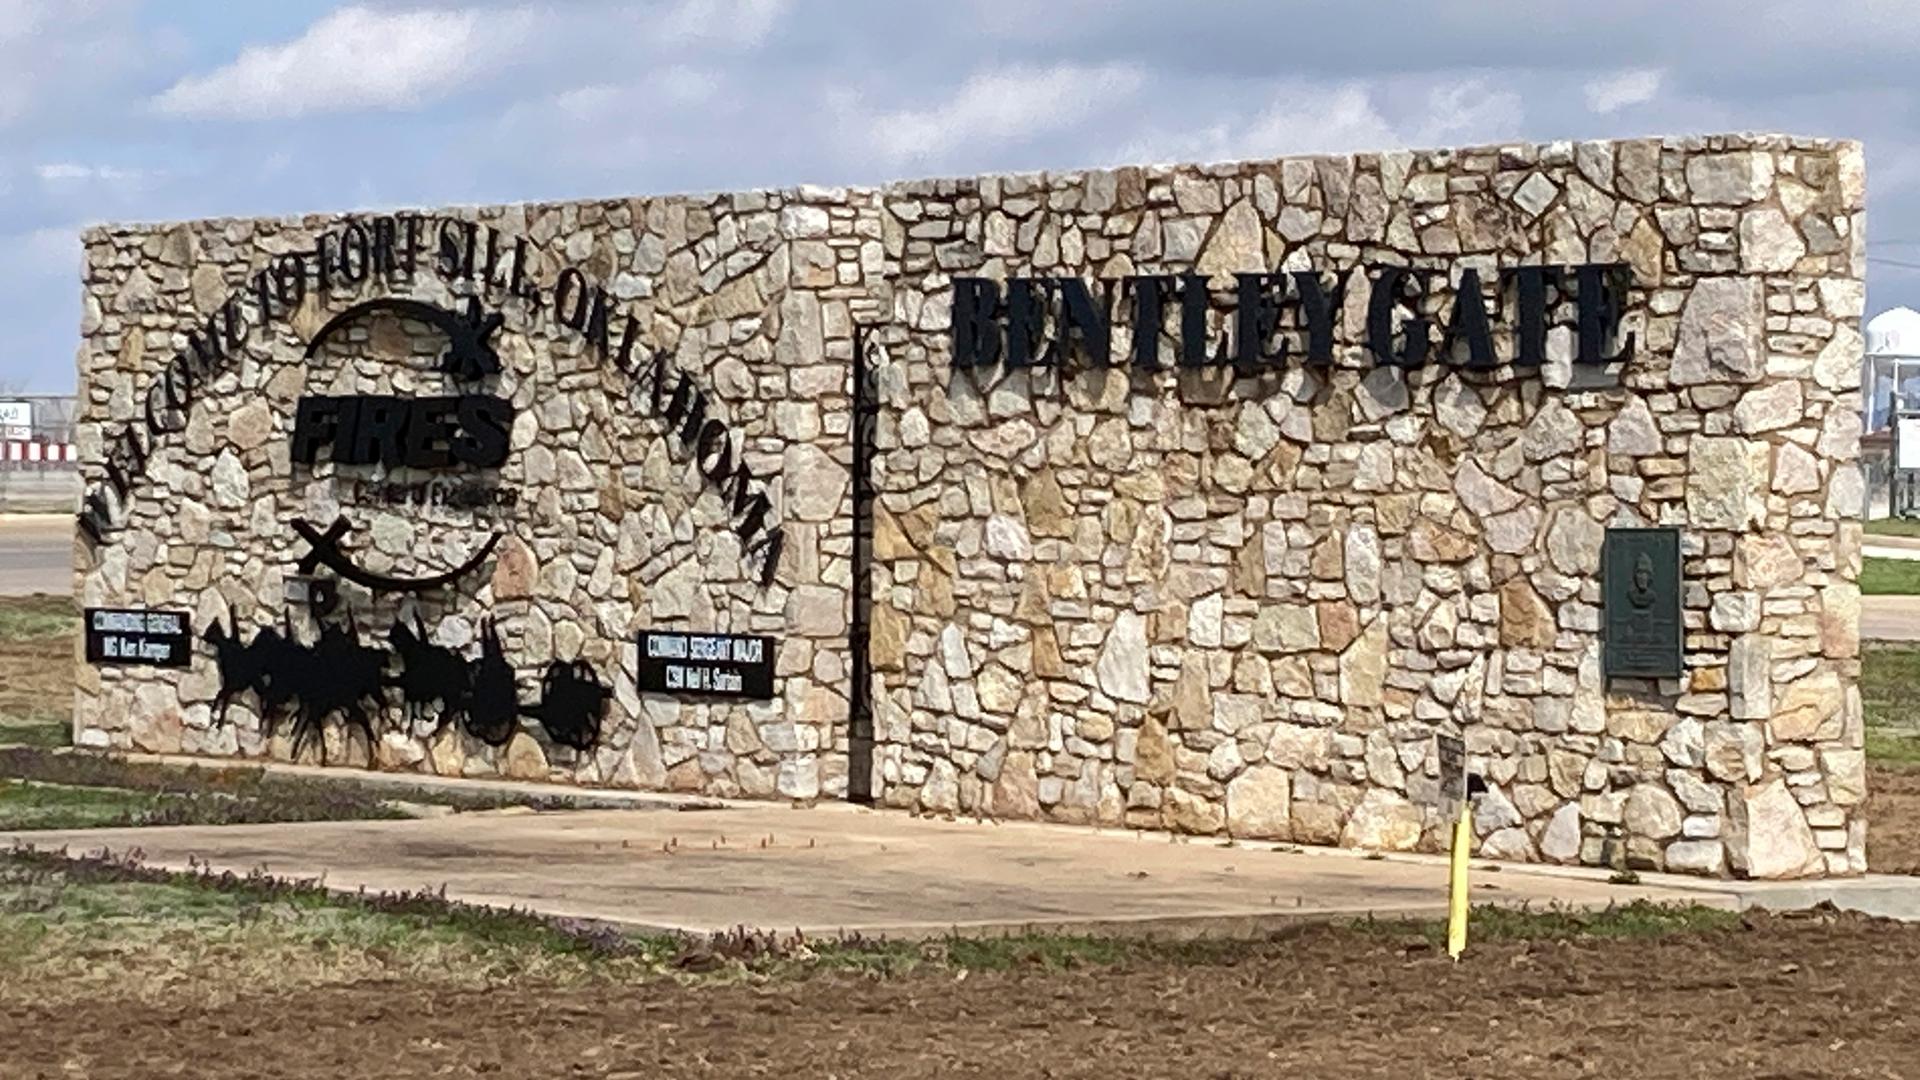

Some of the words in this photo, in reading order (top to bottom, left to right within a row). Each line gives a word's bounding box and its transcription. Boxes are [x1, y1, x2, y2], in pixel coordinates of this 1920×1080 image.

[951, 272, 1339, 368] BENTLEY
[1367, 263, 1637, 369] GATE
[253, 254, 305, 332] TO
[316, 212, 426, 291] FORT
[556, 267, 784, 587] OKLAHOMA
[291, 395, 515, 468] FIRES
